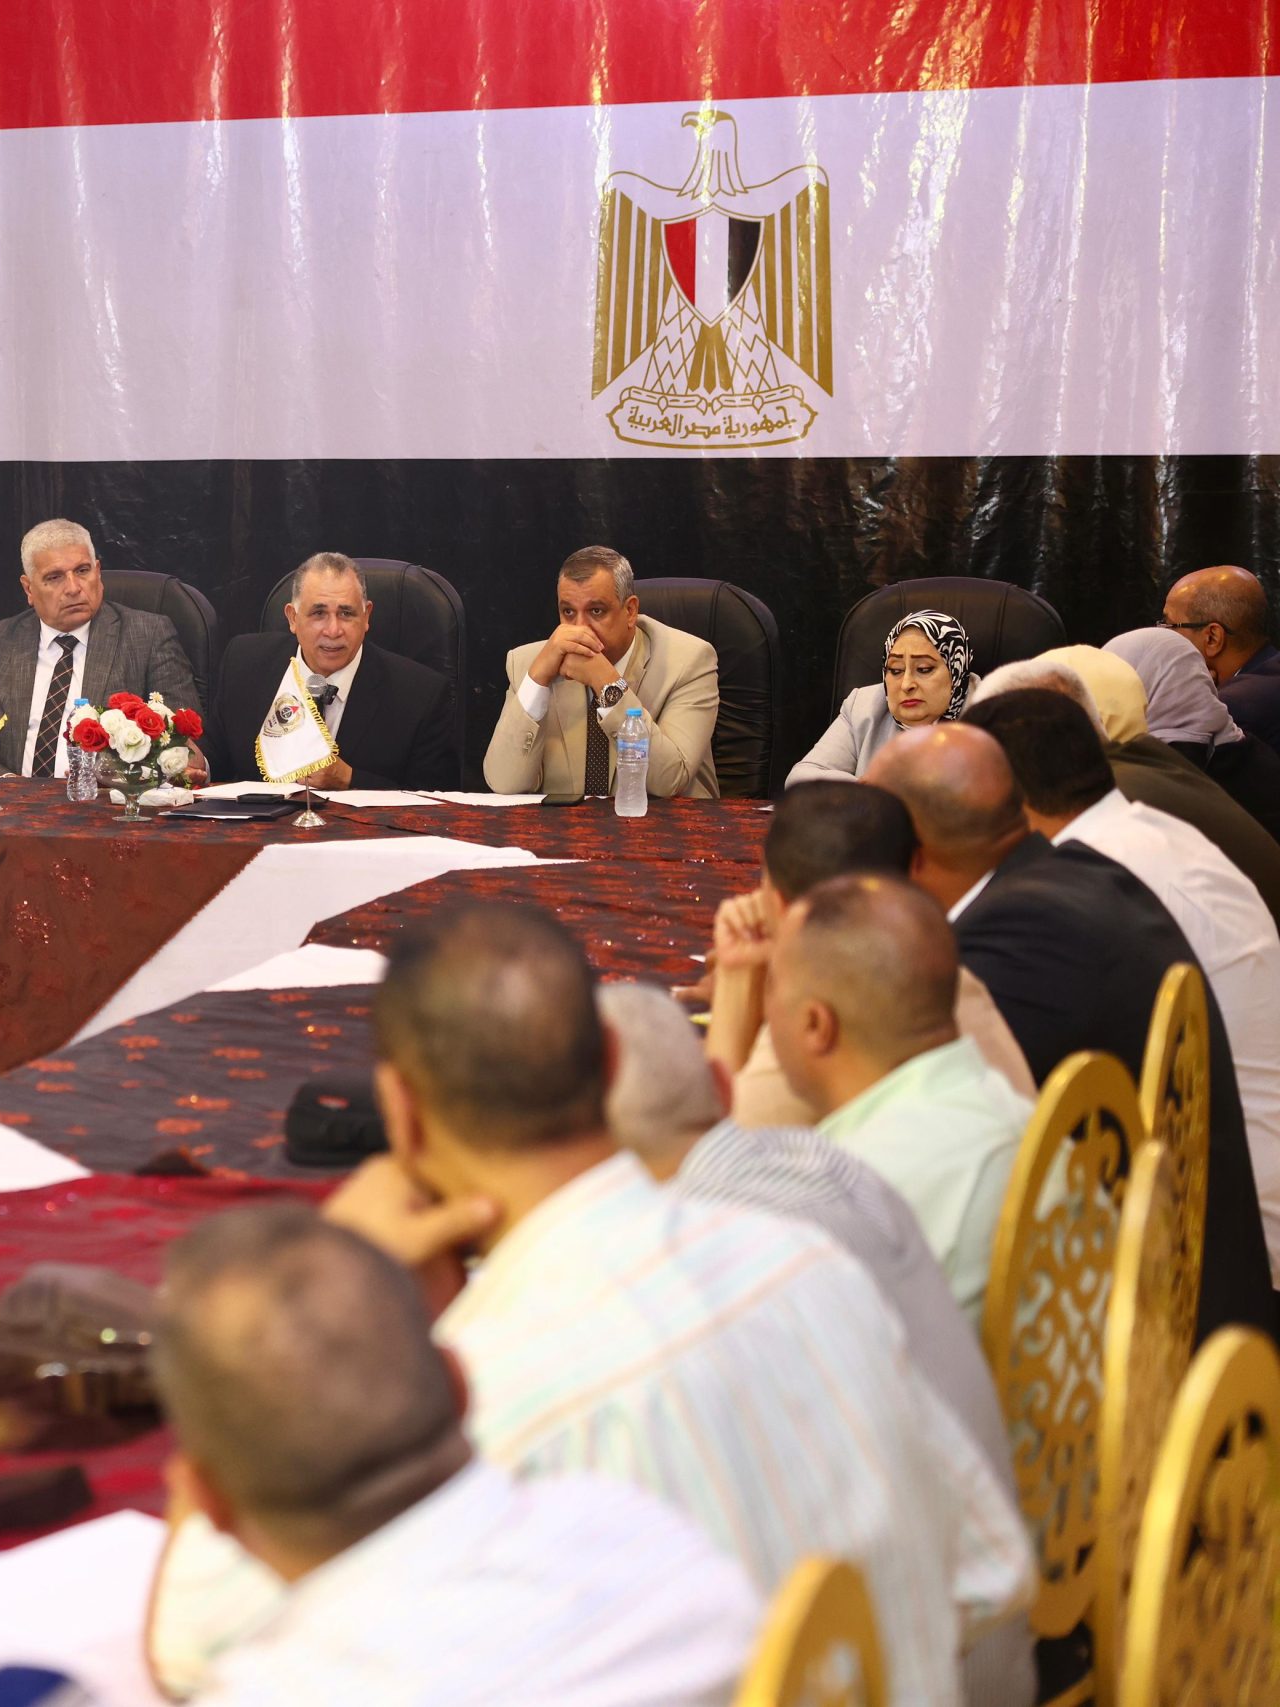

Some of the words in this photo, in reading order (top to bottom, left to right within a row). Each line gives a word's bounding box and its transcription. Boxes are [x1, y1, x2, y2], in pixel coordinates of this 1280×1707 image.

[627, 405, 684, 437] العربية
[680, 420, 721, 439] مصر
[723, 405, 797, 439] جمهورية
